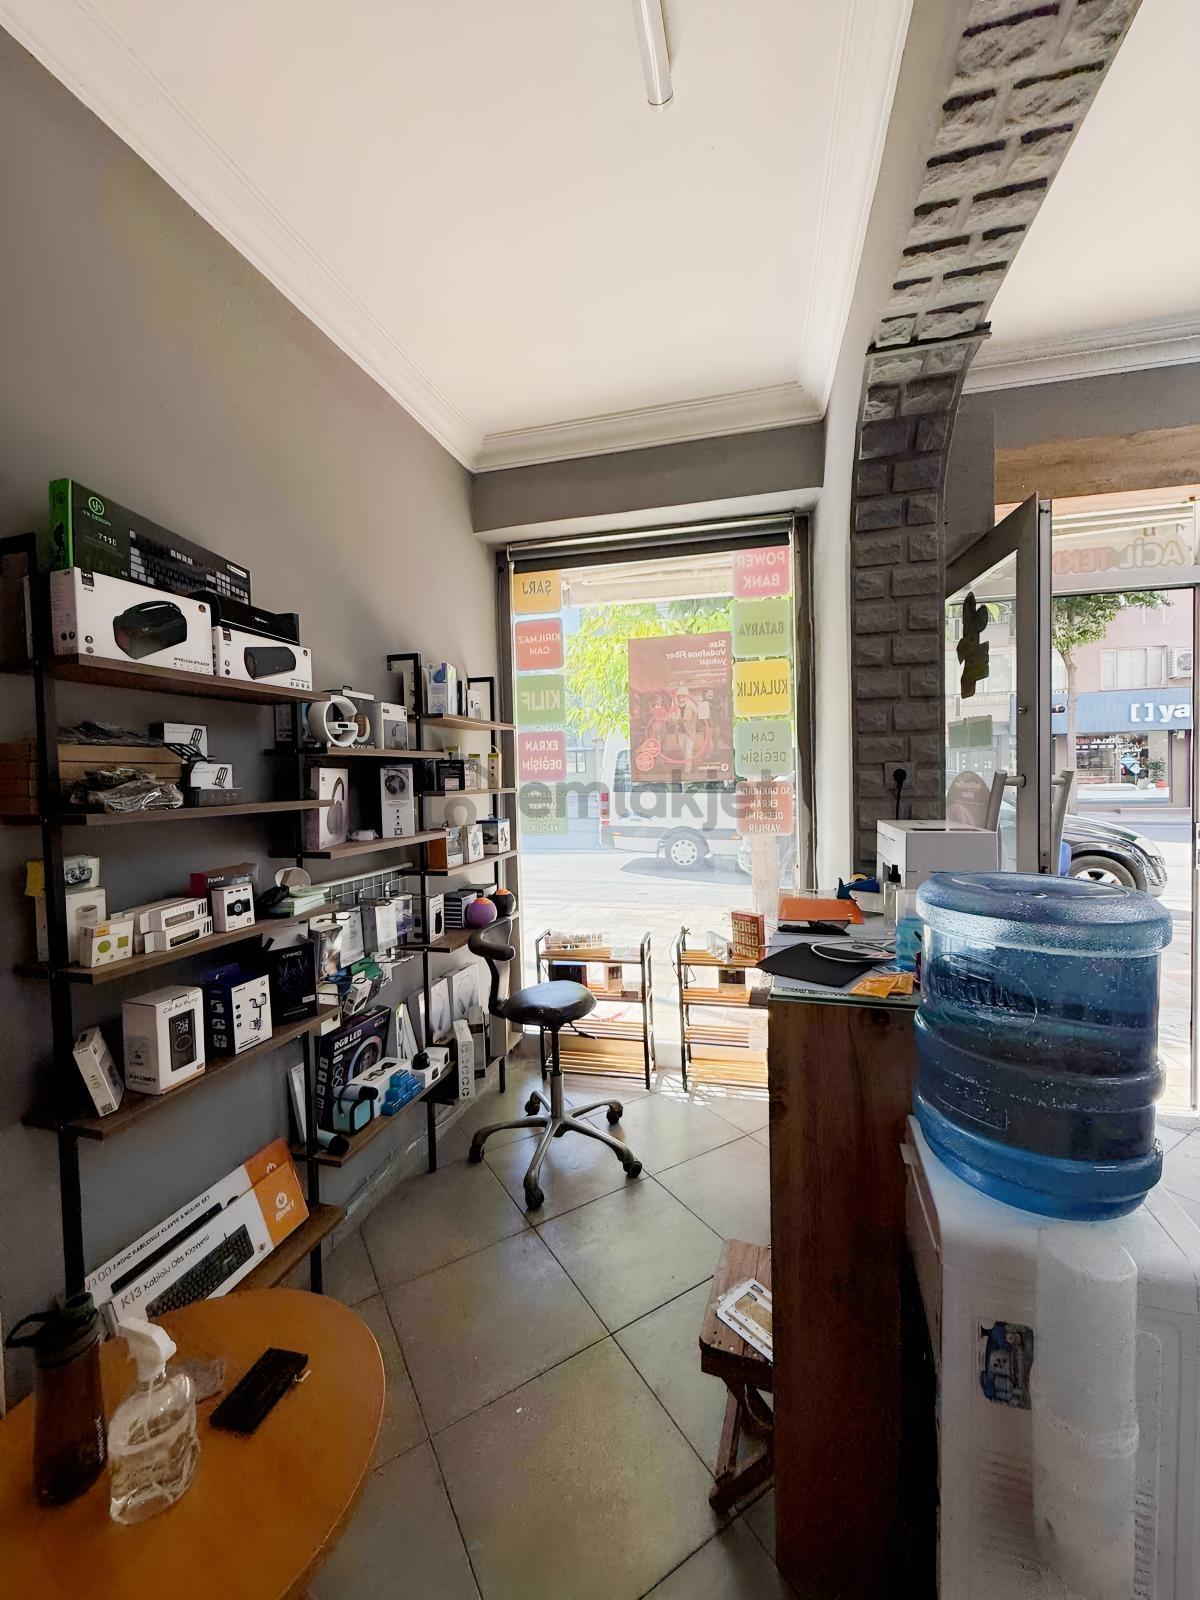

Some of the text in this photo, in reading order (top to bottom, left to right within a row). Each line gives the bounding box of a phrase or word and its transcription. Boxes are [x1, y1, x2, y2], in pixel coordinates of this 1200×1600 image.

[334, 1034, 349, 1051] RGB
[348, 1029, 363, 1043] LED
[120, 1286, 142, 1309] K13
